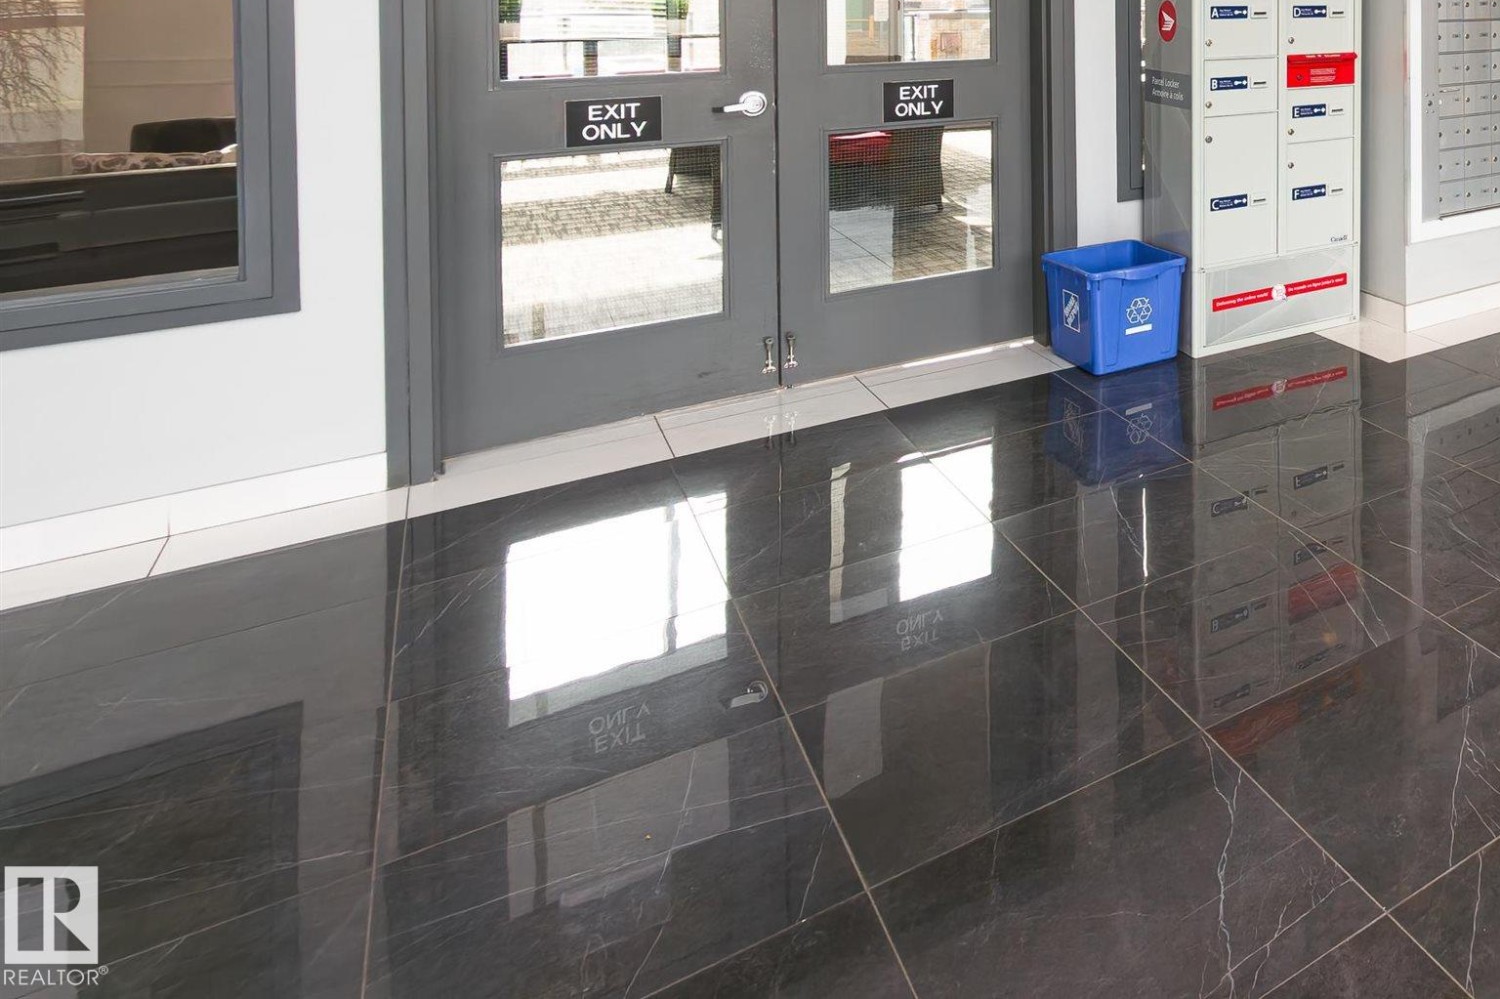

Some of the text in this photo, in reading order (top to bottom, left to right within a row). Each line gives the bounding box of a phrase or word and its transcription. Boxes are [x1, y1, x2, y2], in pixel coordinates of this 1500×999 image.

[1211, 7, 1219, 18] A
[1293, 7, 1301, 17] D
[1211, 79, 1218, 90] B
[899, 85, 939, 100] EXIT
[588, 103, 641, 121] EXIT
[894, 101, 944, 117] ONLY
[1294, 107, 1300, 117] E
[581, 121, 647, 142] ONLY
[1294, 189, 1300, 199] F
[1211, 200, 1220, 210] C
